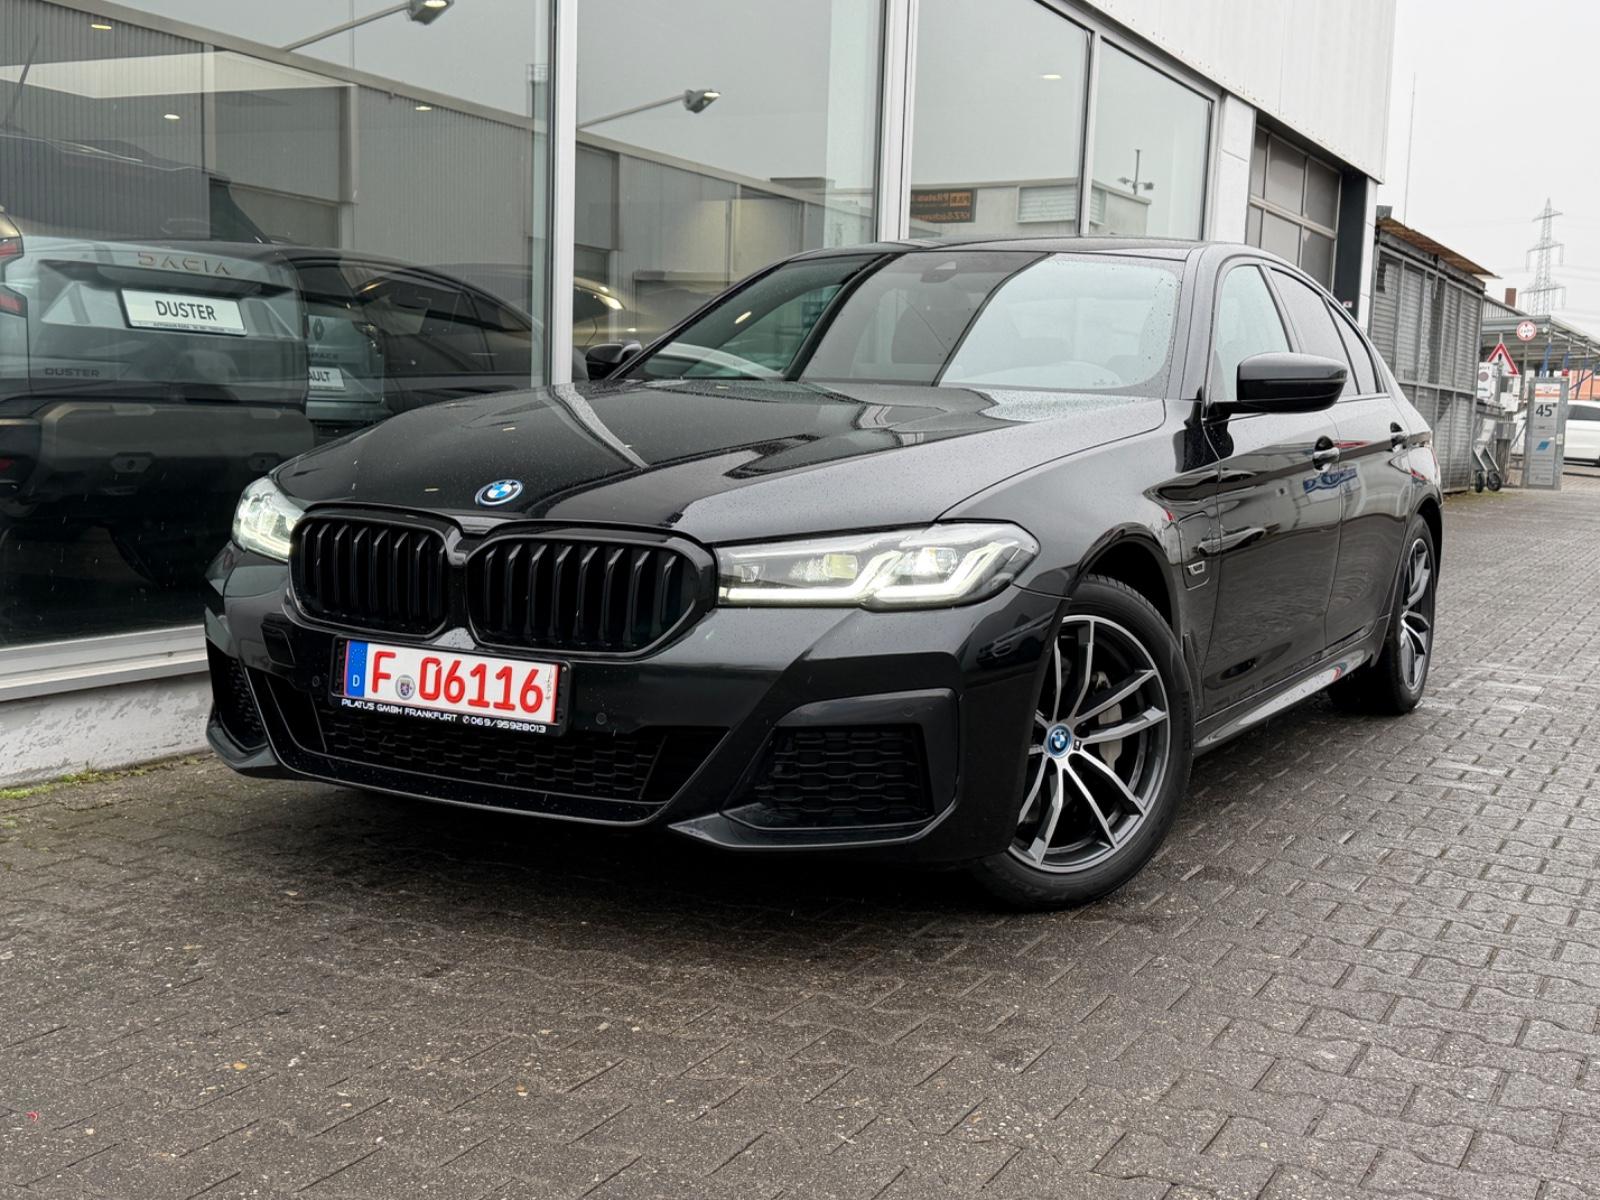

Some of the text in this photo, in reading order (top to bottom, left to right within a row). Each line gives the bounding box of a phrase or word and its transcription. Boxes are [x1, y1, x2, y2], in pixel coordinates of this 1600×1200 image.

[138, 251, 231, 276] DACIA
[155, 300, 217, 321] DUSTER
[44, 367, 100, 378] DUSTER
[352, 674, 360, 687] D
[371, 650, 397, 693] F
[418, 656, 544, 714] 06116
[341, 698, 375, 711] PILATUS
[404, 708, 458, 722] FRANKFURT
[470, 717, 547, 734] 069/95928013
